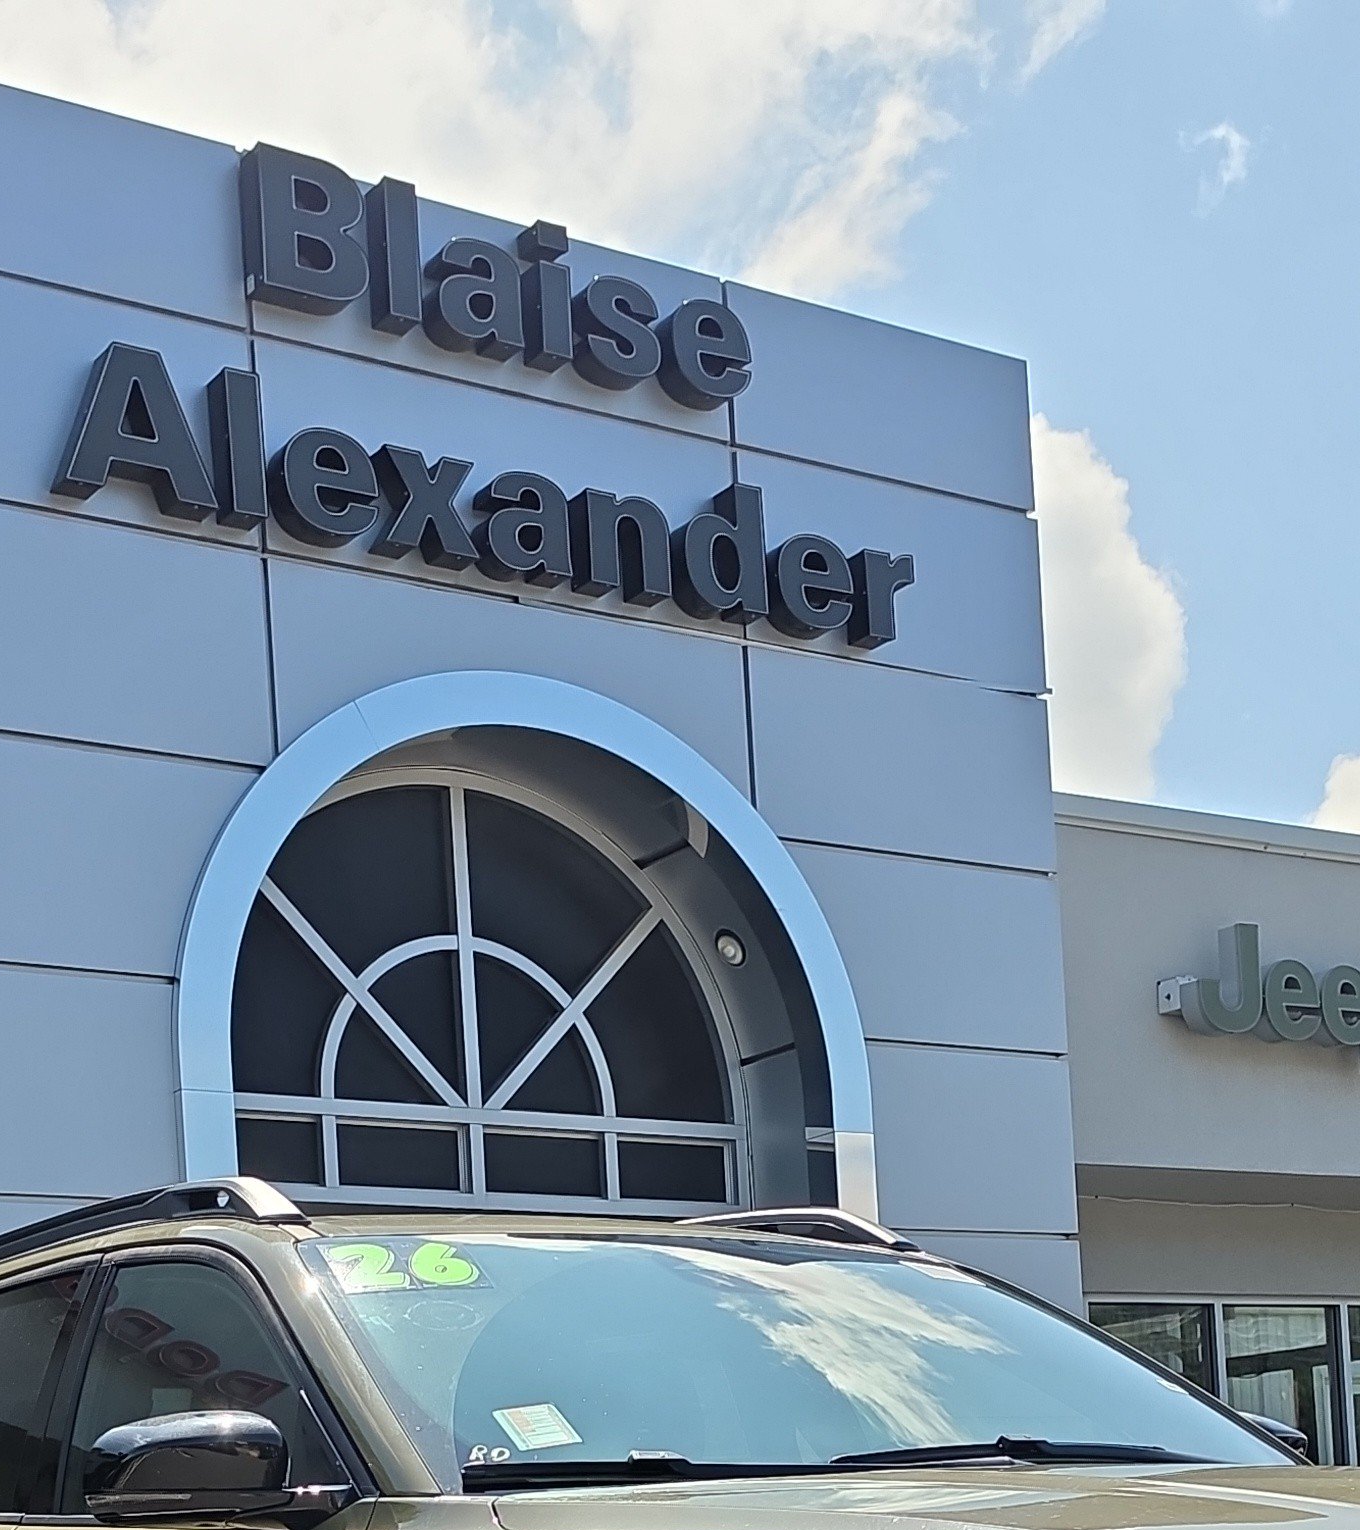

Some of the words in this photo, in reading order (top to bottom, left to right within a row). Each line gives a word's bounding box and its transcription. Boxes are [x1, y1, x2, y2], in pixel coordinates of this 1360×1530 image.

[240, 141, 752, 411] Blaise
[50, 341, 915, 650] Alexander
[326, 1242, 480, 1287] 26
